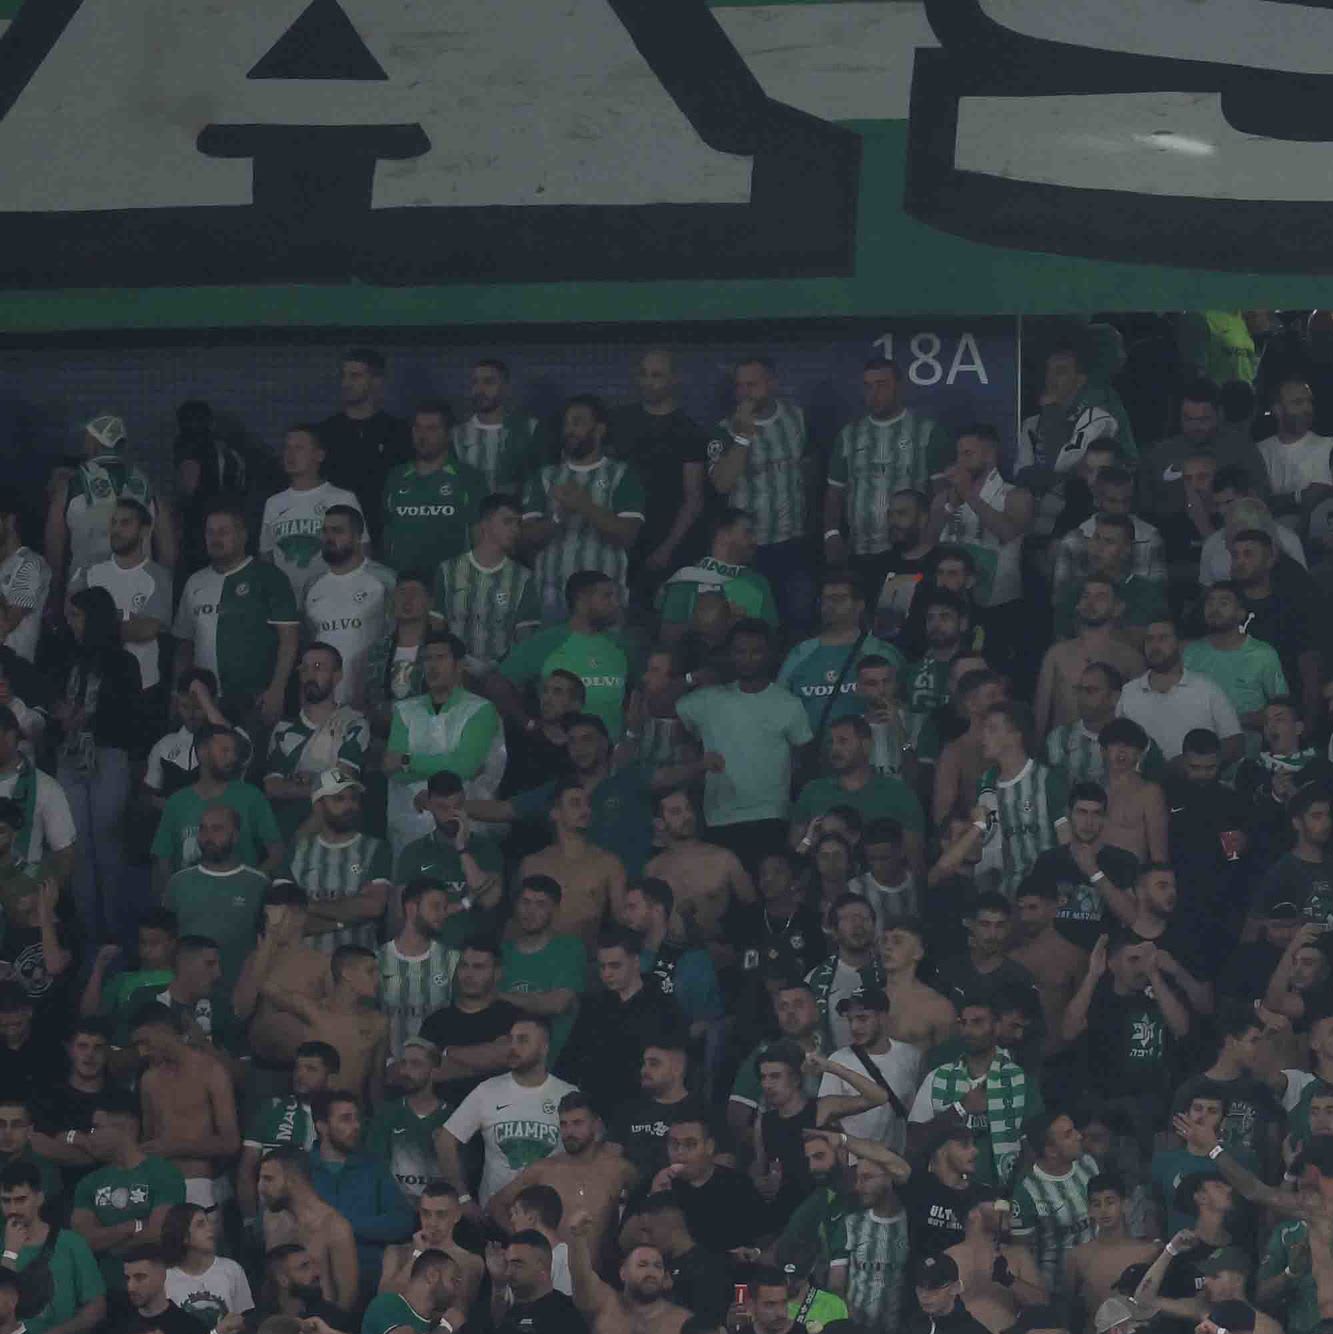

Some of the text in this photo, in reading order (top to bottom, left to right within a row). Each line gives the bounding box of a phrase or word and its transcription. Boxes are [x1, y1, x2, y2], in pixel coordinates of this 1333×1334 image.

[872, 333, 989, 386] 18A
[396, 504, 457, 517] VOLVO
[274, 517, 321, 537] CHAMP
[319, 618, 362, 633] OLVO
[495, 1120, 560, 1145] CHAMPS
